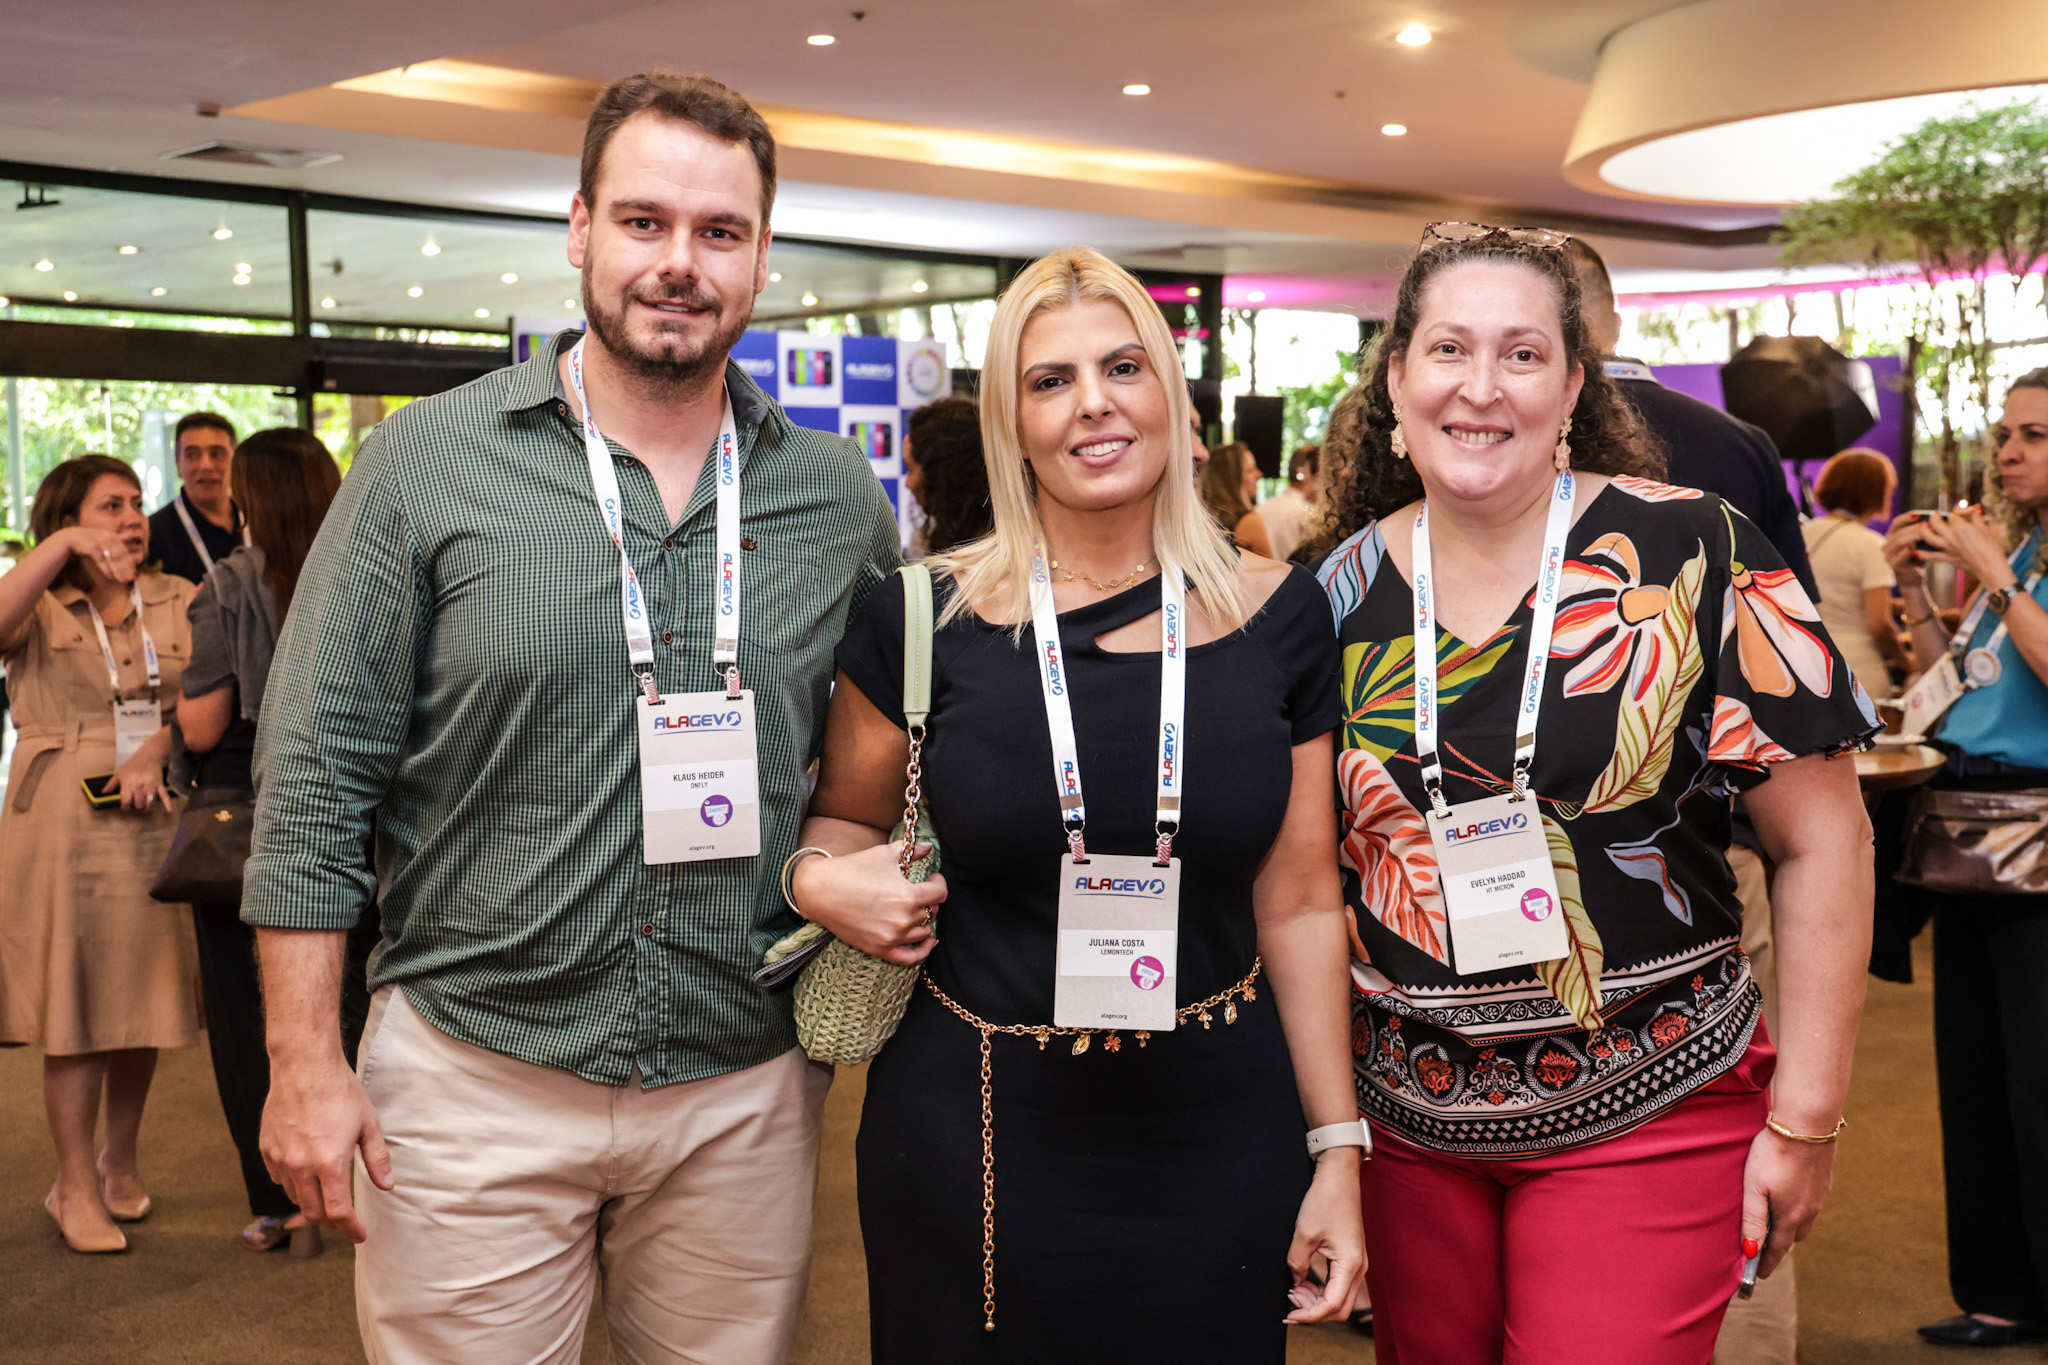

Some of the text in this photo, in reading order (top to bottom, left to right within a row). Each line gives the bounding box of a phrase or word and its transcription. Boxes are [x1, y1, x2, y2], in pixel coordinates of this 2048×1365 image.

[673, 770, 724, 782] KLAUS HEIDER
[1470, 870, 1526, 889] EVELYN HADDAD
[1494, 882, 1515, 892] MICRON
[1088, 938, 1145, 948] JULIANA COSTA
[1498, 949, 1524, 959] alagev.org
[1100, 1012, 1128, 1020] alagev.org
